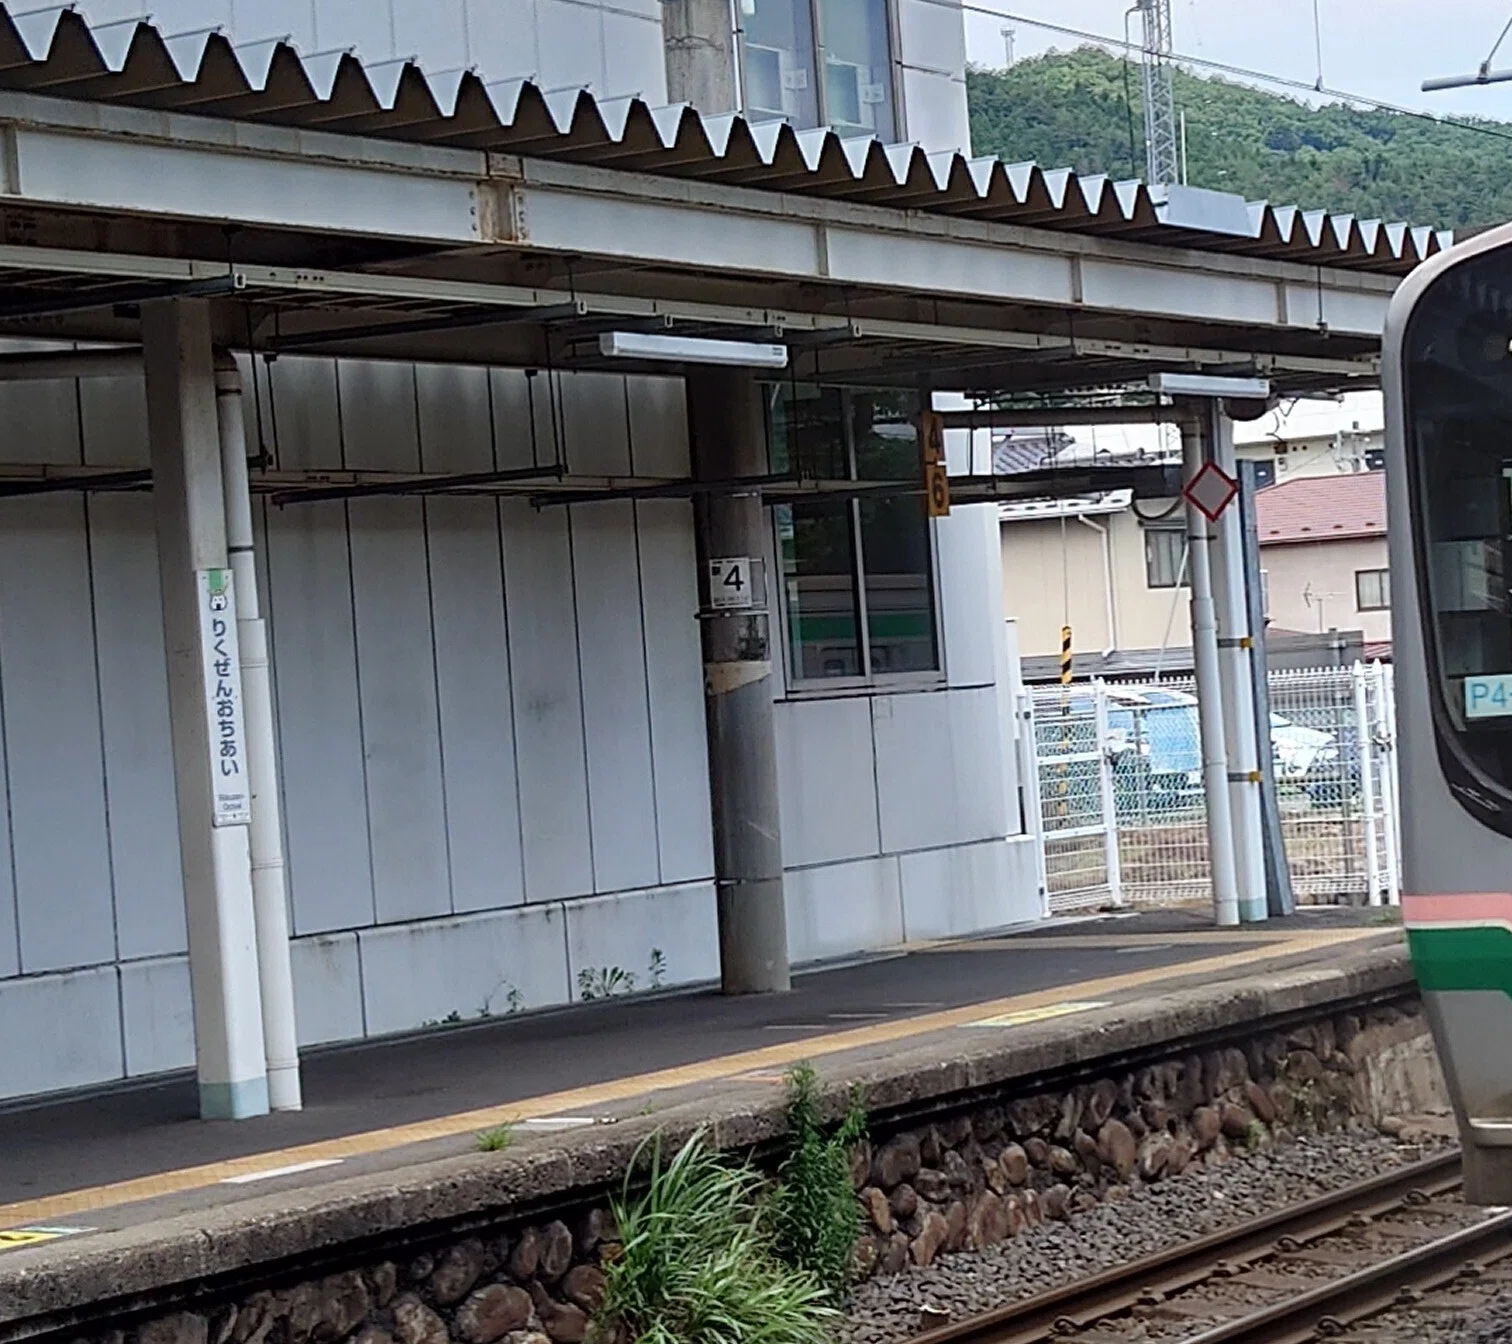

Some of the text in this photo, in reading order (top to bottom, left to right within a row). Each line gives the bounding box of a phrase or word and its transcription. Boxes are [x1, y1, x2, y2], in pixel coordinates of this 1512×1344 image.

[722, 564, 745, 592] 4
[212, 618, 240, 776] りくぜんおちあい
